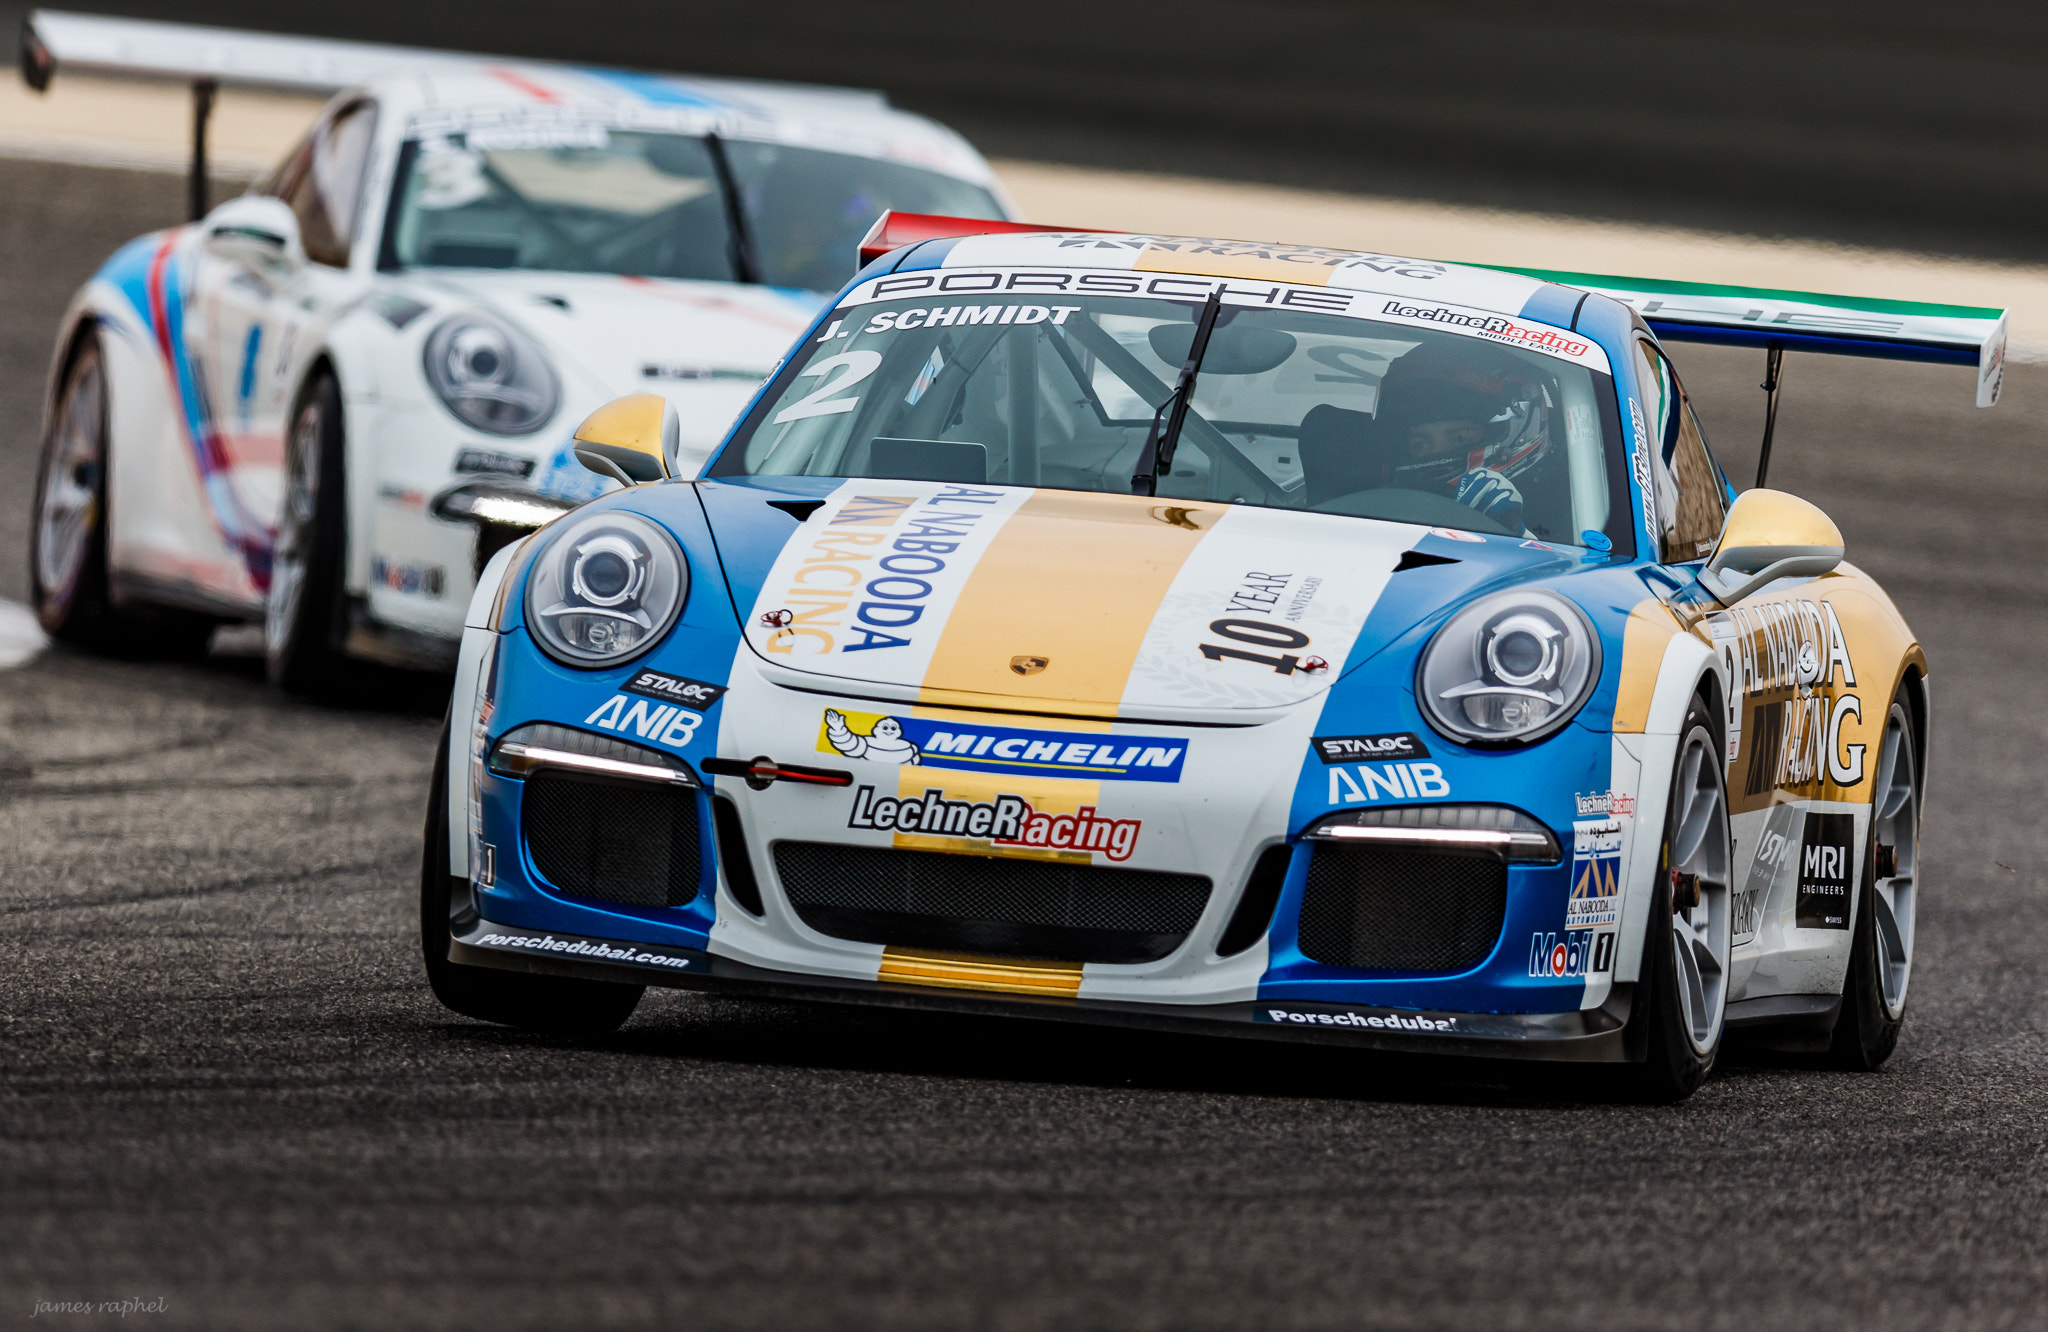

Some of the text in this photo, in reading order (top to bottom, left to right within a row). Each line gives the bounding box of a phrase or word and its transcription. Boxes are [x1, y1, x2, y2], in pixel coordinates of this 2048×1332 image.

[1189, 247, 1442, 280] RACING
[871, 273, 1355, 311] PORSCHE
[816, 305, 1082, 343] J. SCHMIDT
[1477, 331, 1564, 354] MIDDLE EAST
[773, 350, 883, 425] 2
[843, 484, 1006, 653] AL NABOODA
[766, 530, 874, 656] RACING
[1225, 571, 1293, 615] YEAR
[1285, 575, 1324, 624] ANNIVERSARY
[1198, 618, 1311, 677] 10
[1731, 607, 1764, 700] AL
[635, 673, 716, 701] STALOC
[584, 694, 703, 748] ANIB
[1773, 694, 1867, 788] RACING
[924, 732, 1183, 768] MICHELIN
[1321, 736, 1414, 753] STALOC
[1328, 763, 1450, 805] ANIB
[1804, 844, 1846, 879] MRI
[1568, 899, 1609, 915] AL NABOODA
[1802, 884, 1844, 895] ENGINEERS
[1566, 913, 1616, 925] AUTOMOBILES
[1529, 929, 1609, 978] Mobil 1
